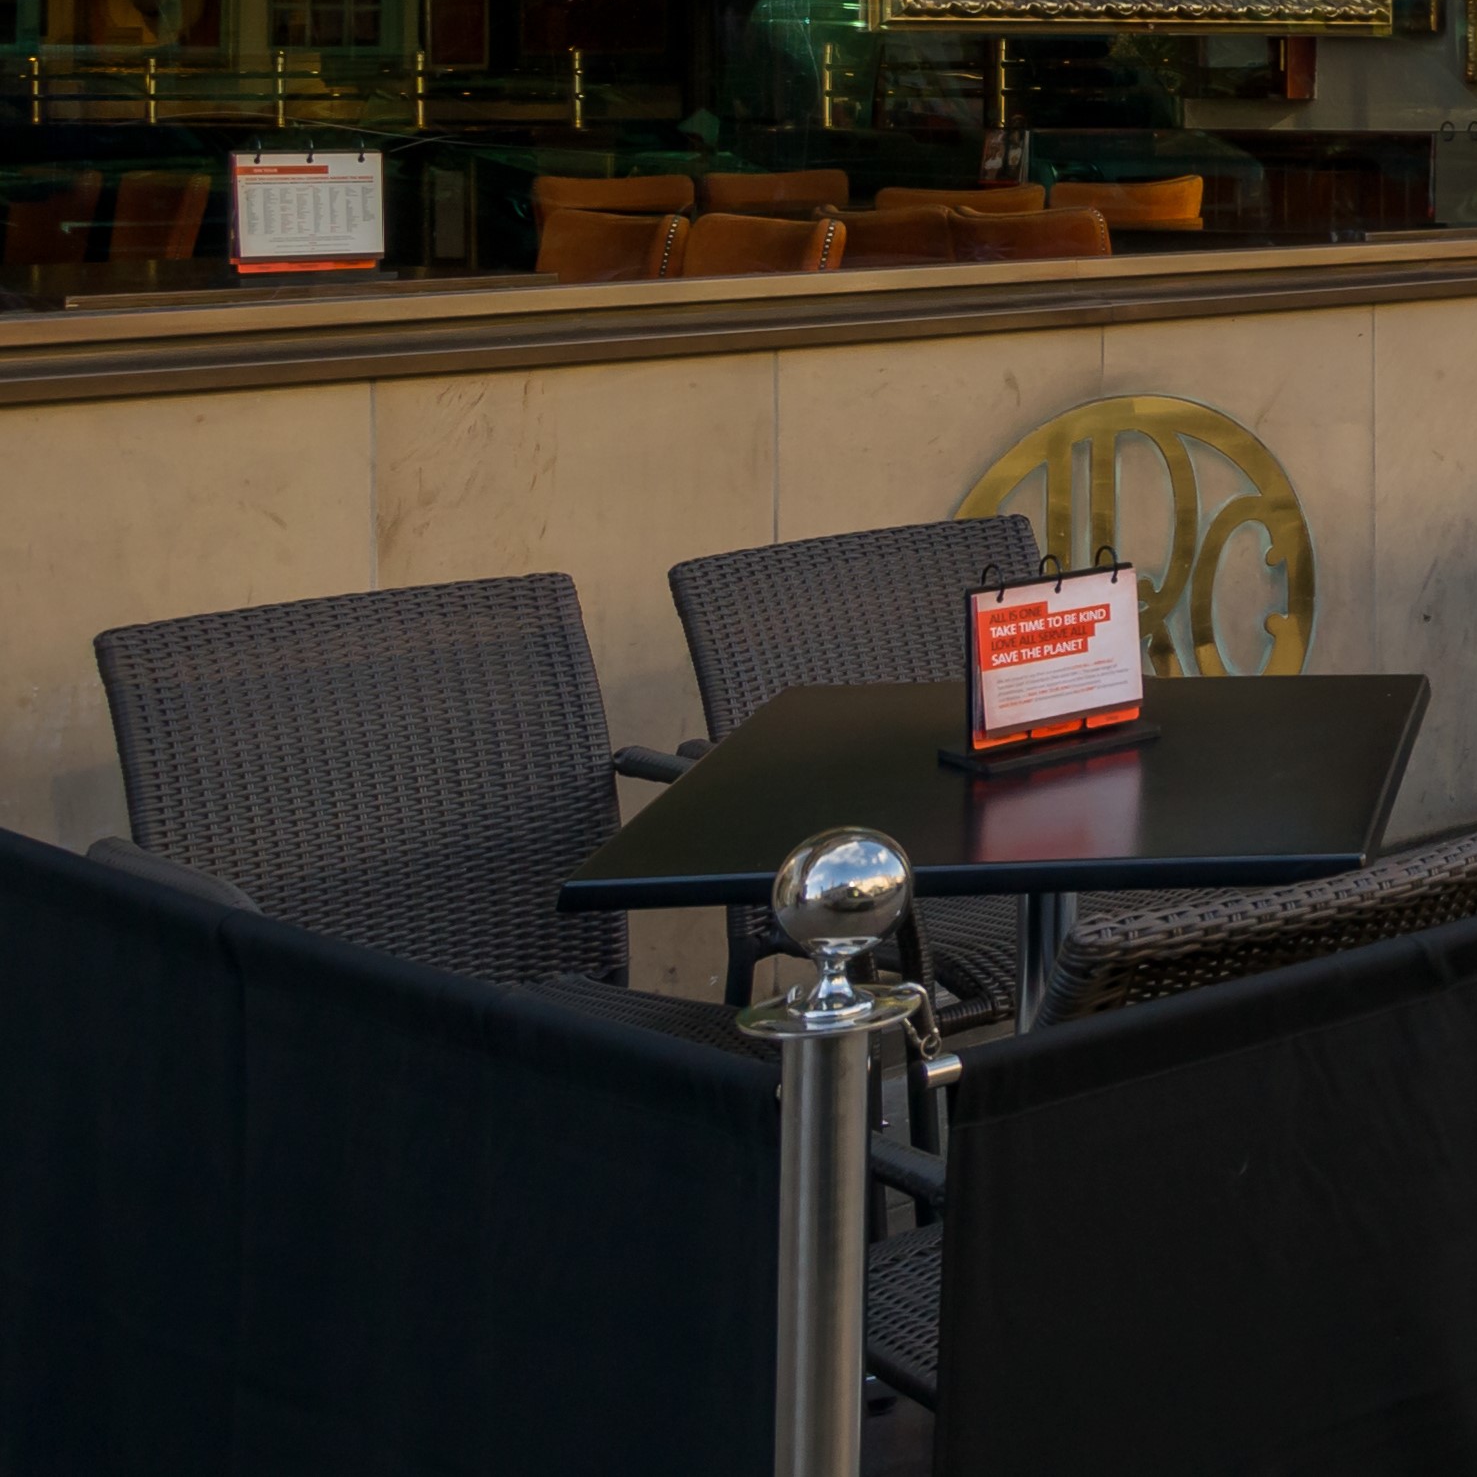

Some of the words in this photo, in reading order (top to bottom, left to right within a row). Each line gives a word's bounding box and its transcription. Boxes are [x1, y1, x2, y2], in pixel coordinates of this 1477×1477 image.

[989, 612, 1007, 623] ALL
[1009, 610, 1018, 620] IS
[1019, 606, 1043, 619] ONE
[989, 624, 1017, 639] TAKE
[1018, 620, 1045, 634] TIME
[1047, 617, 1062, 628] TO
[1063, 613, 1077, 625] BE
[1079, 608, 1107, 622] KIND
[990, 638, 1016, 652] LOVE
[1018, 634, 1037, 646] ALL
[1038, 628, 1068, 643] SERVE
[1070, 625, 1087, 637] ALL
[991, 652, 1019, 667] SAVE
[1020, 646, 1042, 659] THE
[1043, 637, 1084, 657] PLANET
